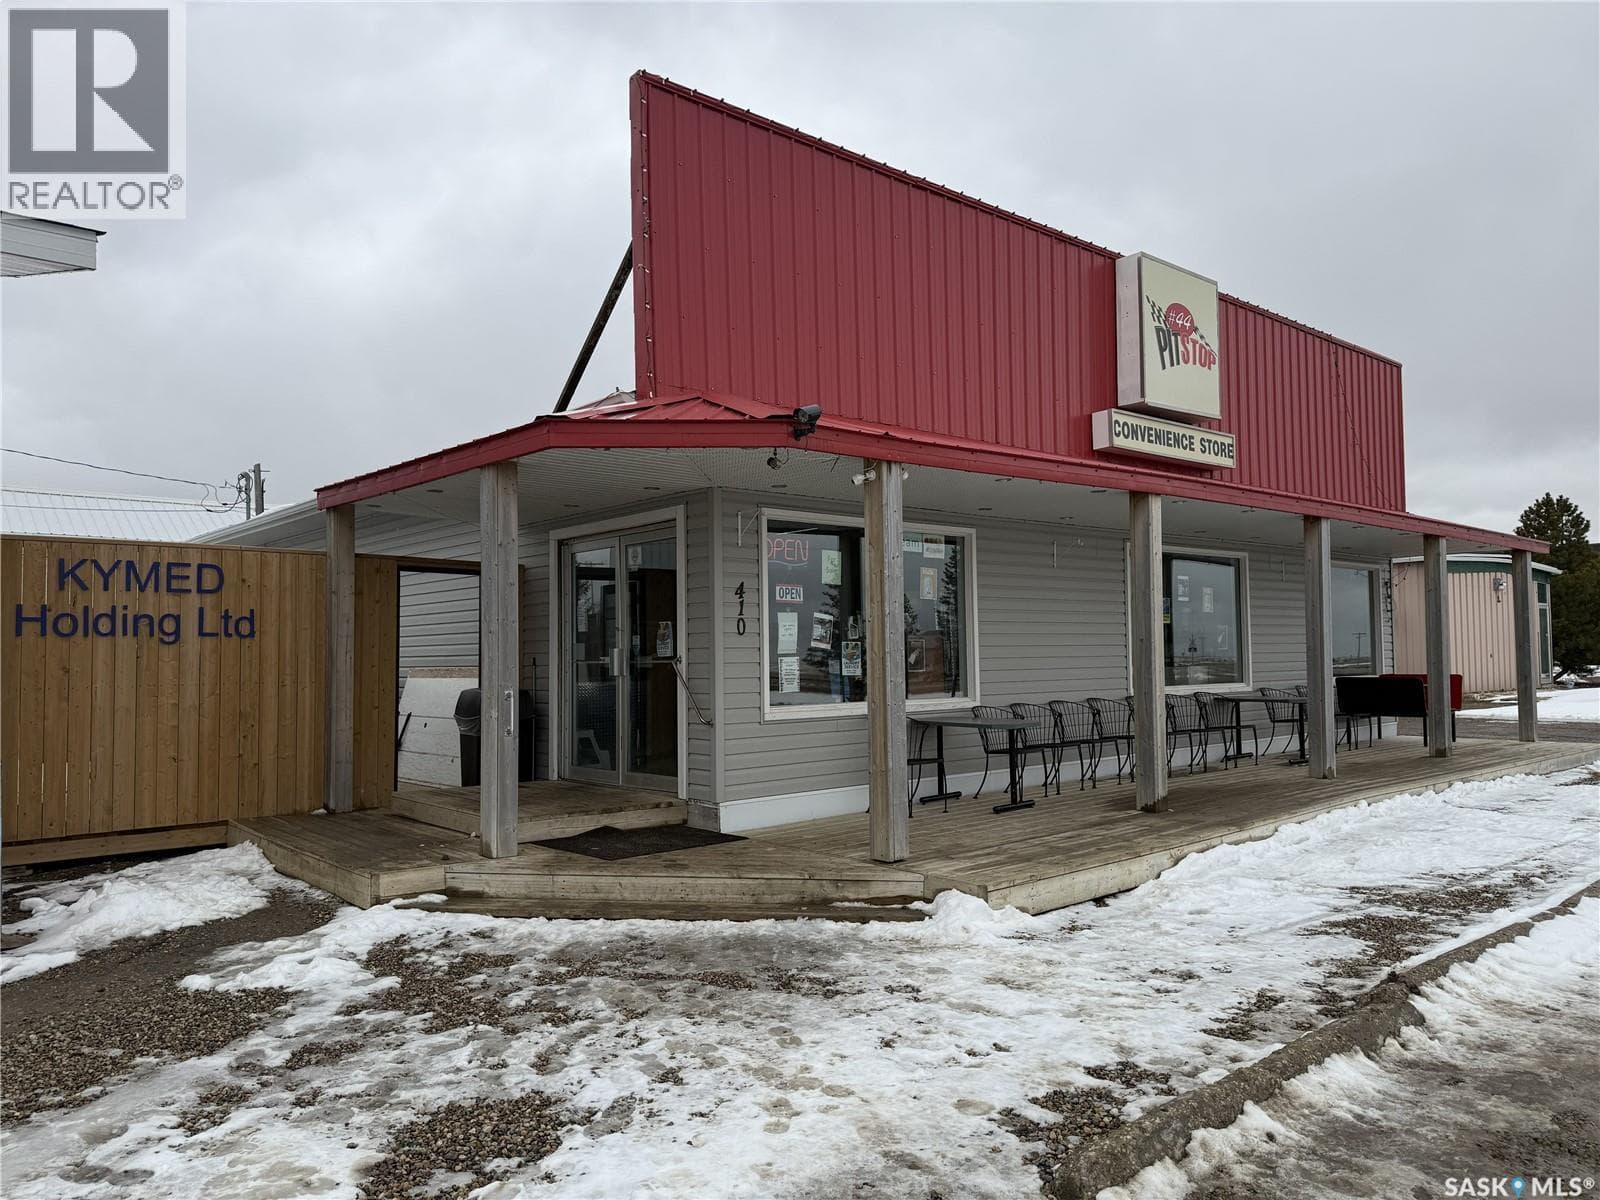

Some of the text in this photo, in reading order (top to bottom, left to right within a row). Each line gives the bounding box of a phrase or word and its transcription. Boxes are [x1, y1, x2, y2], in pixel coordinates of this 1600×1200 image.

[1167, 309, 1192, 330] #44
[1113, 419, 1235, 460] CONVENIENCE STORE
[58, 558, 225, 594] KYMED
[778, 587, 802, 600] OPEN
[15, 604, 256, 645] Holding Ltd
